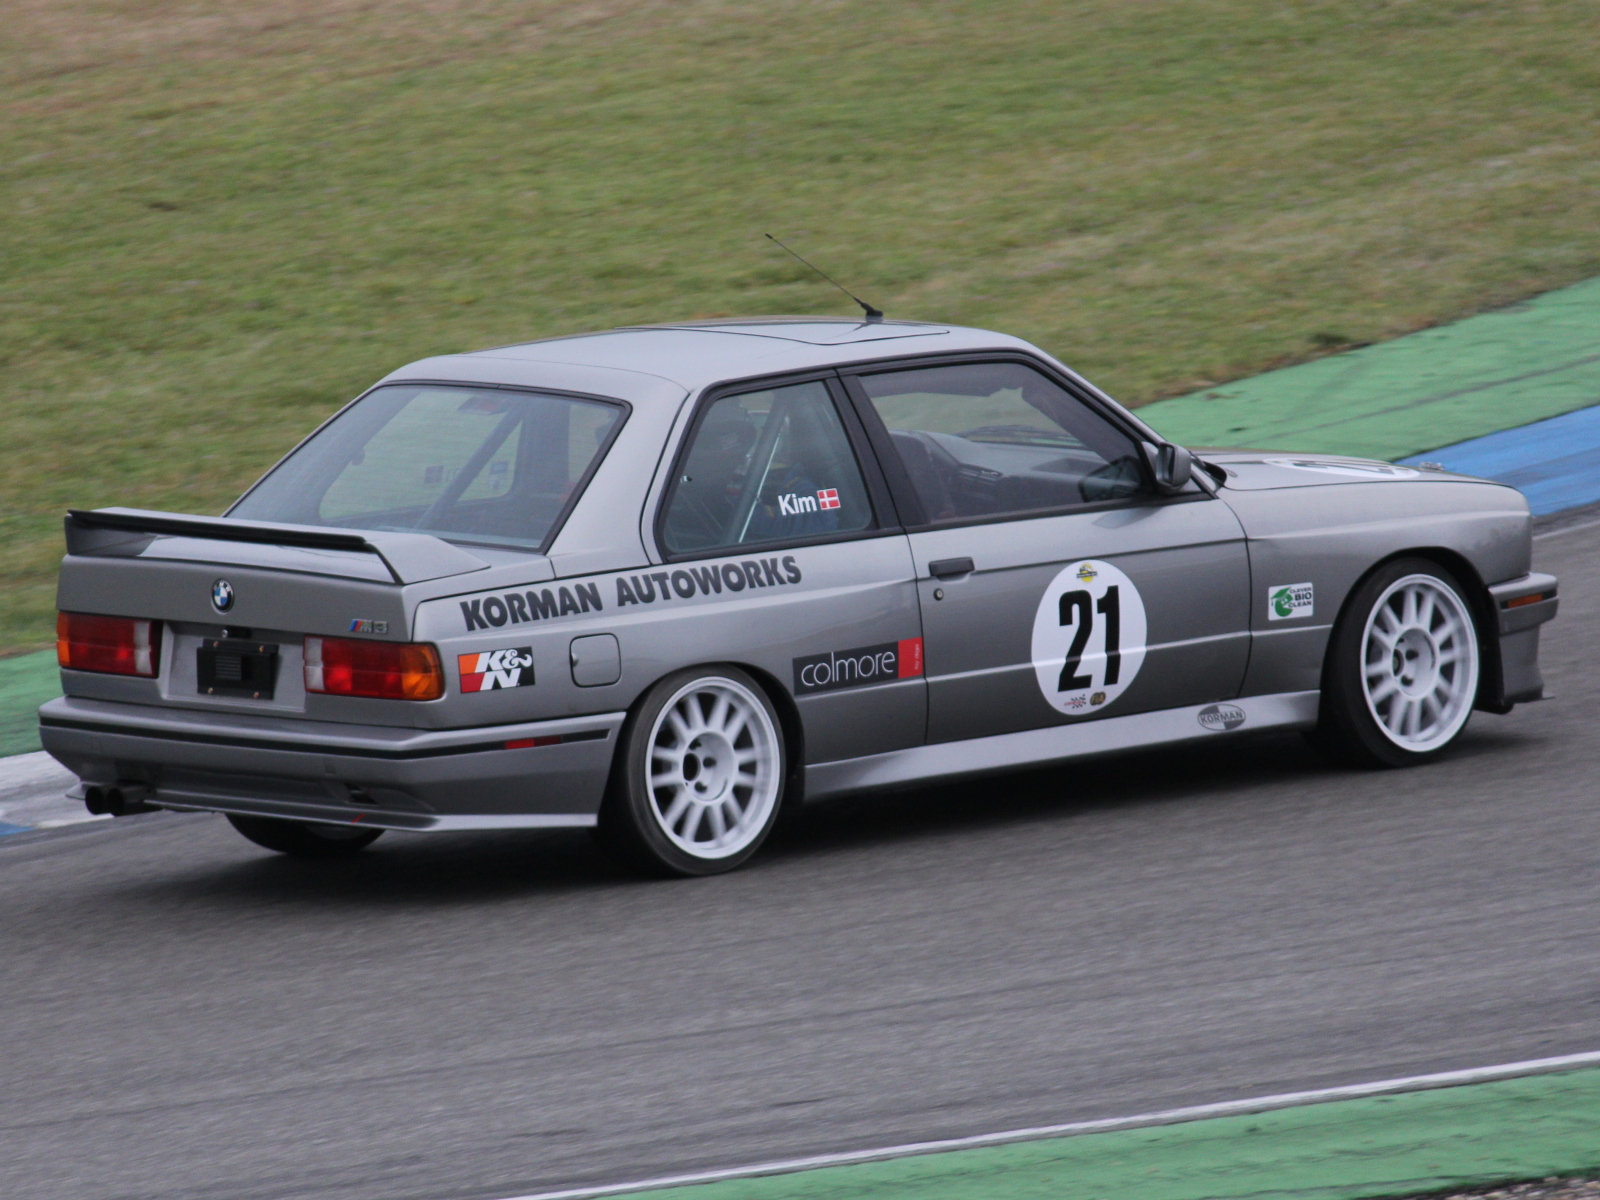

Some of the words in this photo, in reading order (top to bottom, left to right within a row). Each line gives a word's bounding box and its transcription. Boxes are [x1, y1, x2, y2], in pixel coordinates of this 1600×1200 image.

[778, 493, 818, 516] Kim
[459, 582, 603, 632] KORMAN
[616, 555, 802, 607] AUTOWORKS
[1288, 600, 1312, 608] CLEAN
[1294, 592, 1312, 601] BIO
[1057, 585, 1121, 693] 21
[801, 651, 896, 687] colmore
[1200, 710, 1244, 724] KORMAN
